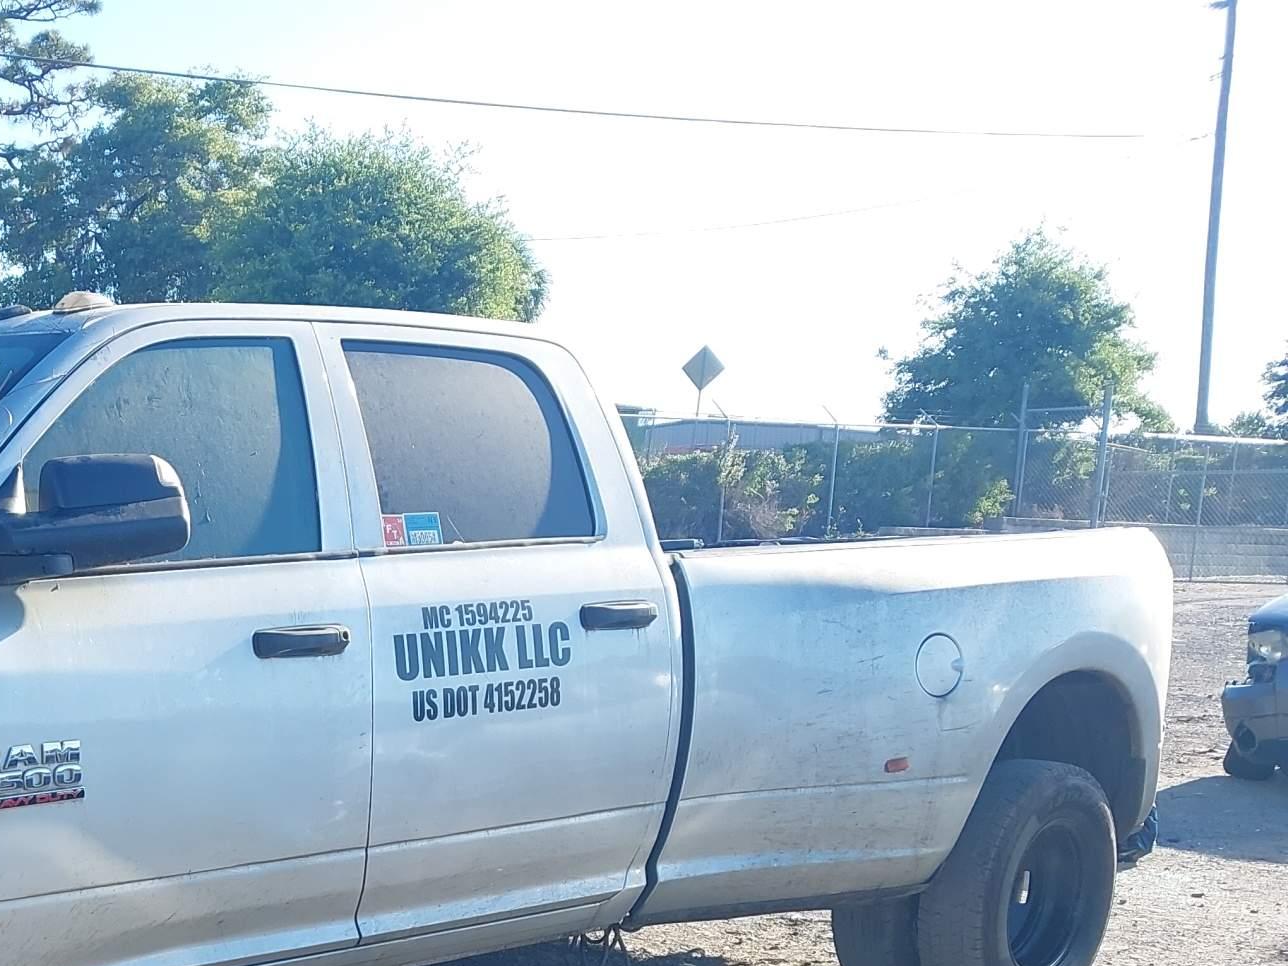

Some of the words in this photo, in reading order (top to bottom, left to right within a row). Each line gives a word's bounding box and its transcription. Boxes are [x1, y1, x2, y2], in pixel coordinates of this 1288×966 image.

[422, 605, 452, 630] MC
[455, 600, 533, 626] 1594225
[393, 625, 509, 681] UNIKK
[515, 621, 571, 670] LLC
[412, 688, 438, 722] US
[443, 684, 479, 719] DOT
[483, 676, 561, 713] 4152258
[36, 788, 81, 803] DUTY
